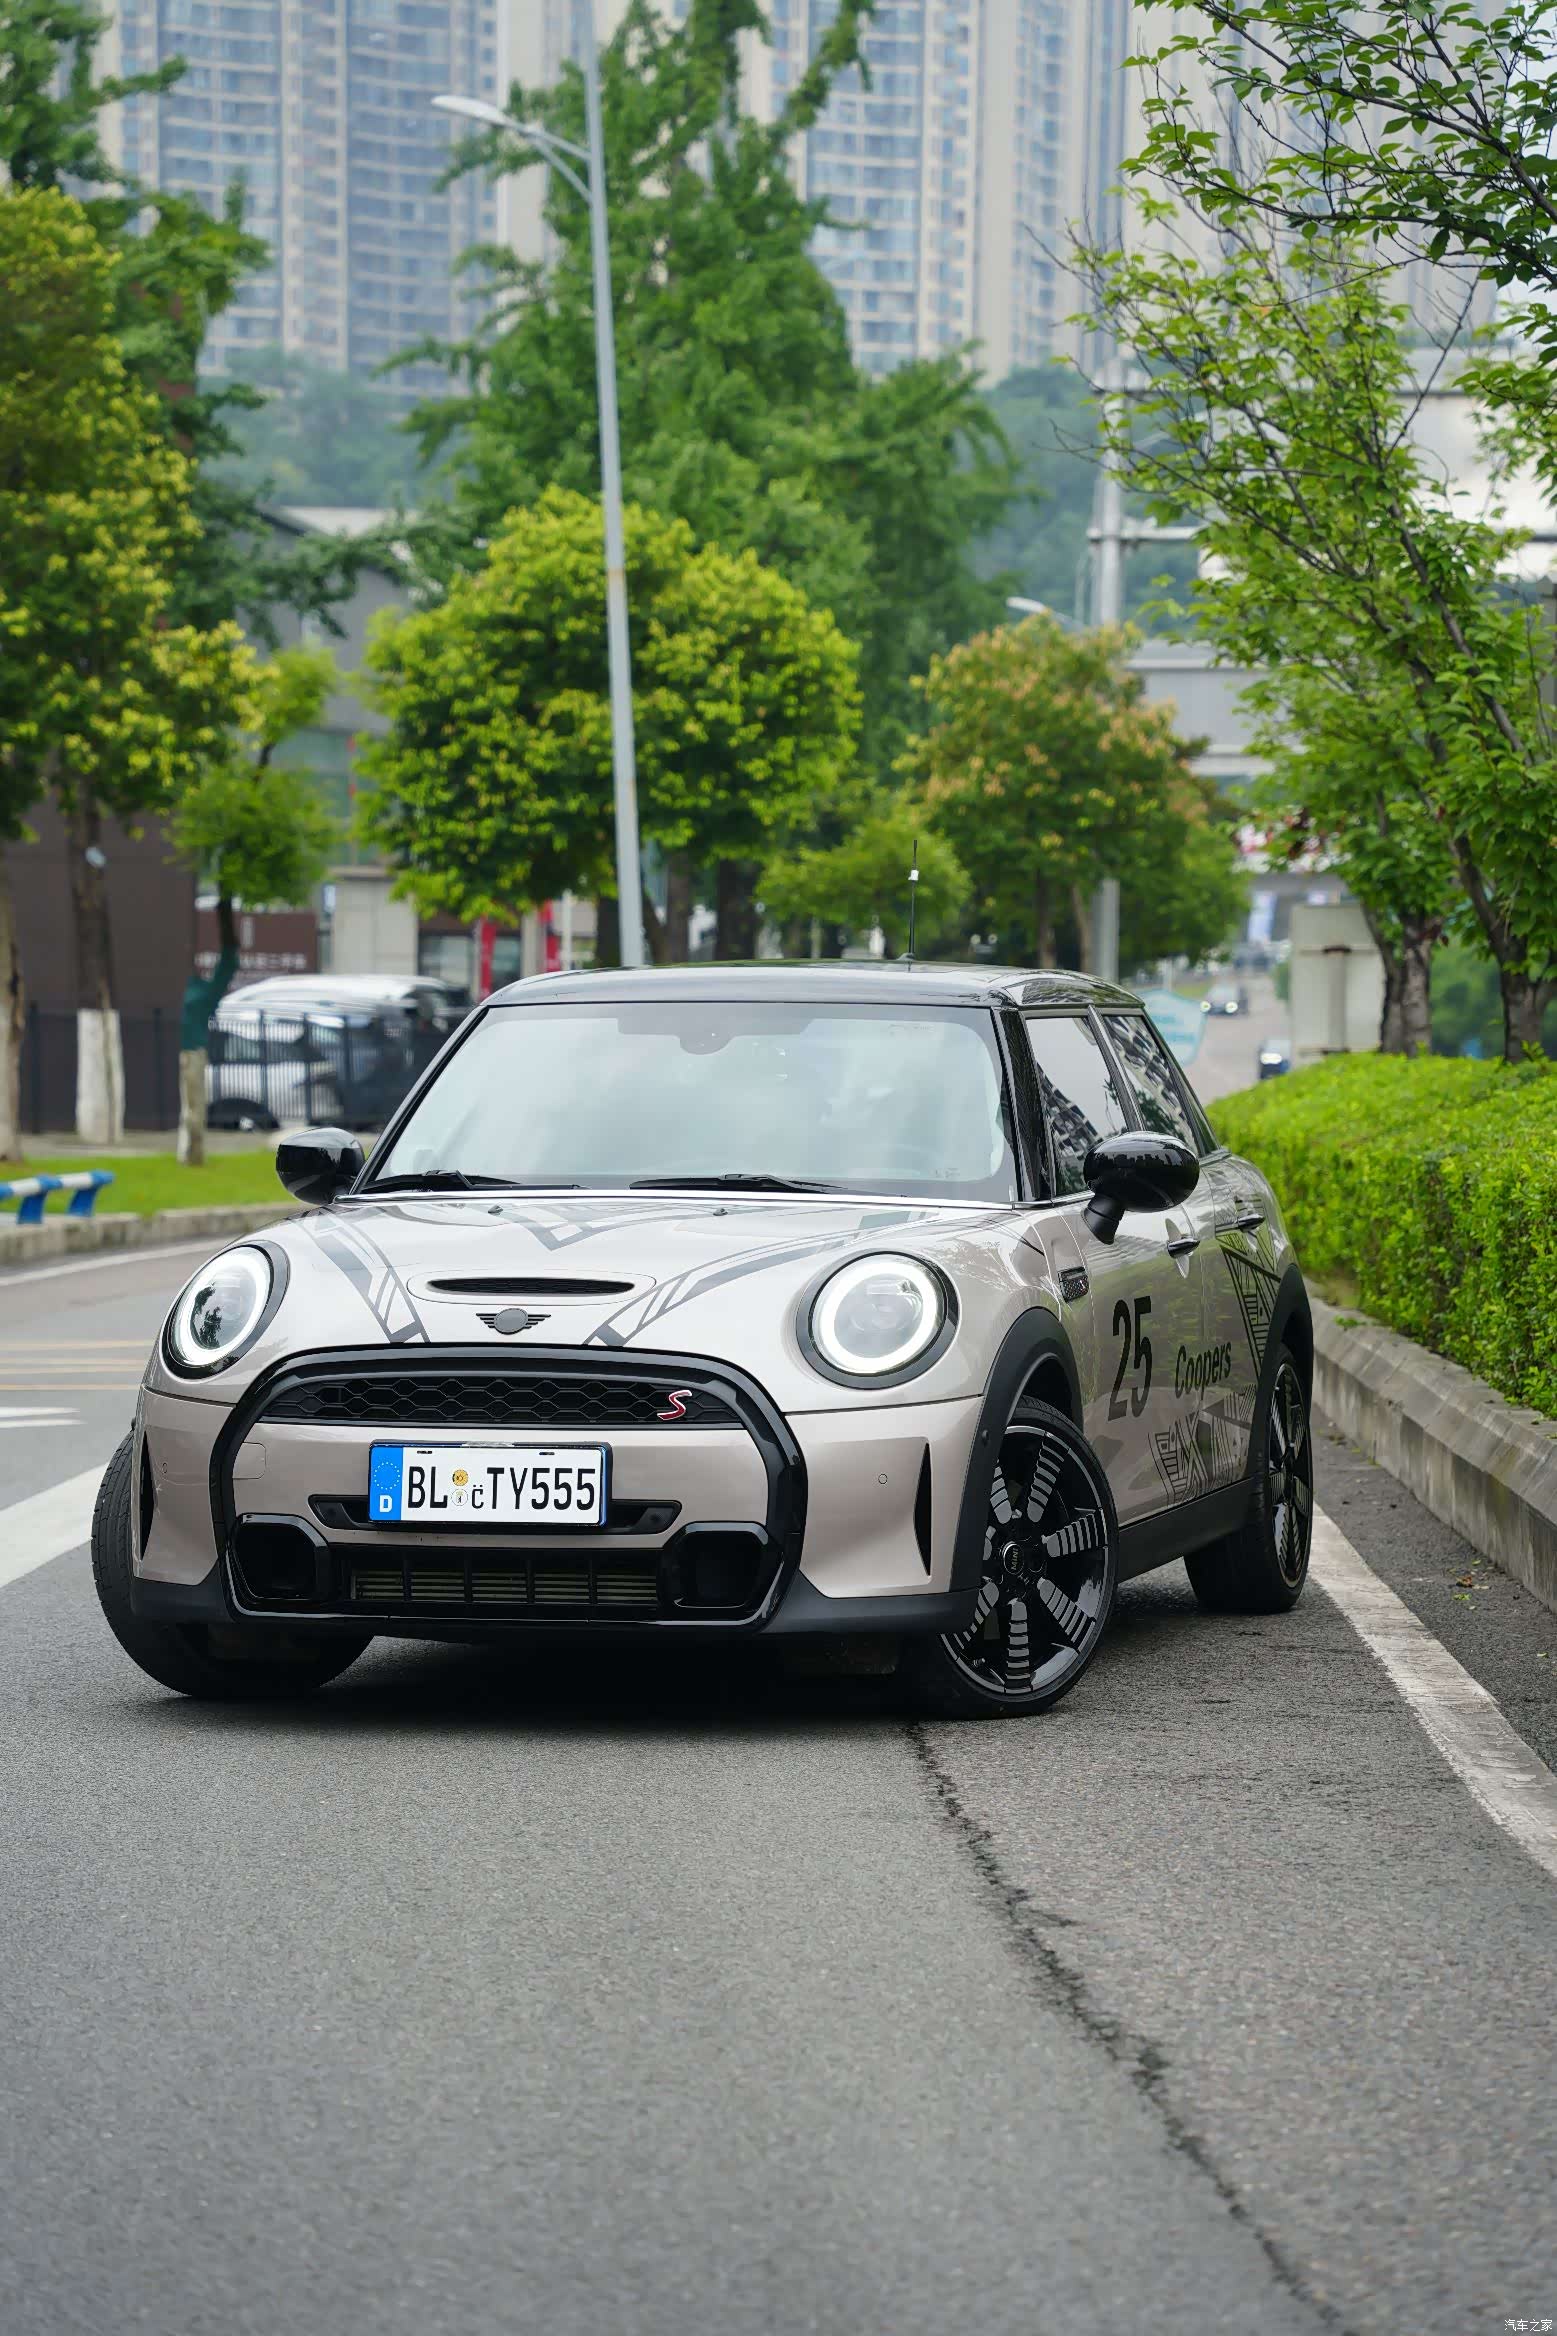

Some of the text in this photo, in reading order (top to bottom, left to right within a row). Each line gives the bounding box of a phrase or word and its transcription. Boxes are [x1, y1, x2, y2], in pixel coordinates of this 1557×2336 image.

[1107, 1295, 1152, 1421] 25
[656, 1389, 693, 1421] S
[407, 1466, 448, 1509] BL
[379, 1495, 393, 1513] D
[1010, 1547, 1019, 1570] MINI
